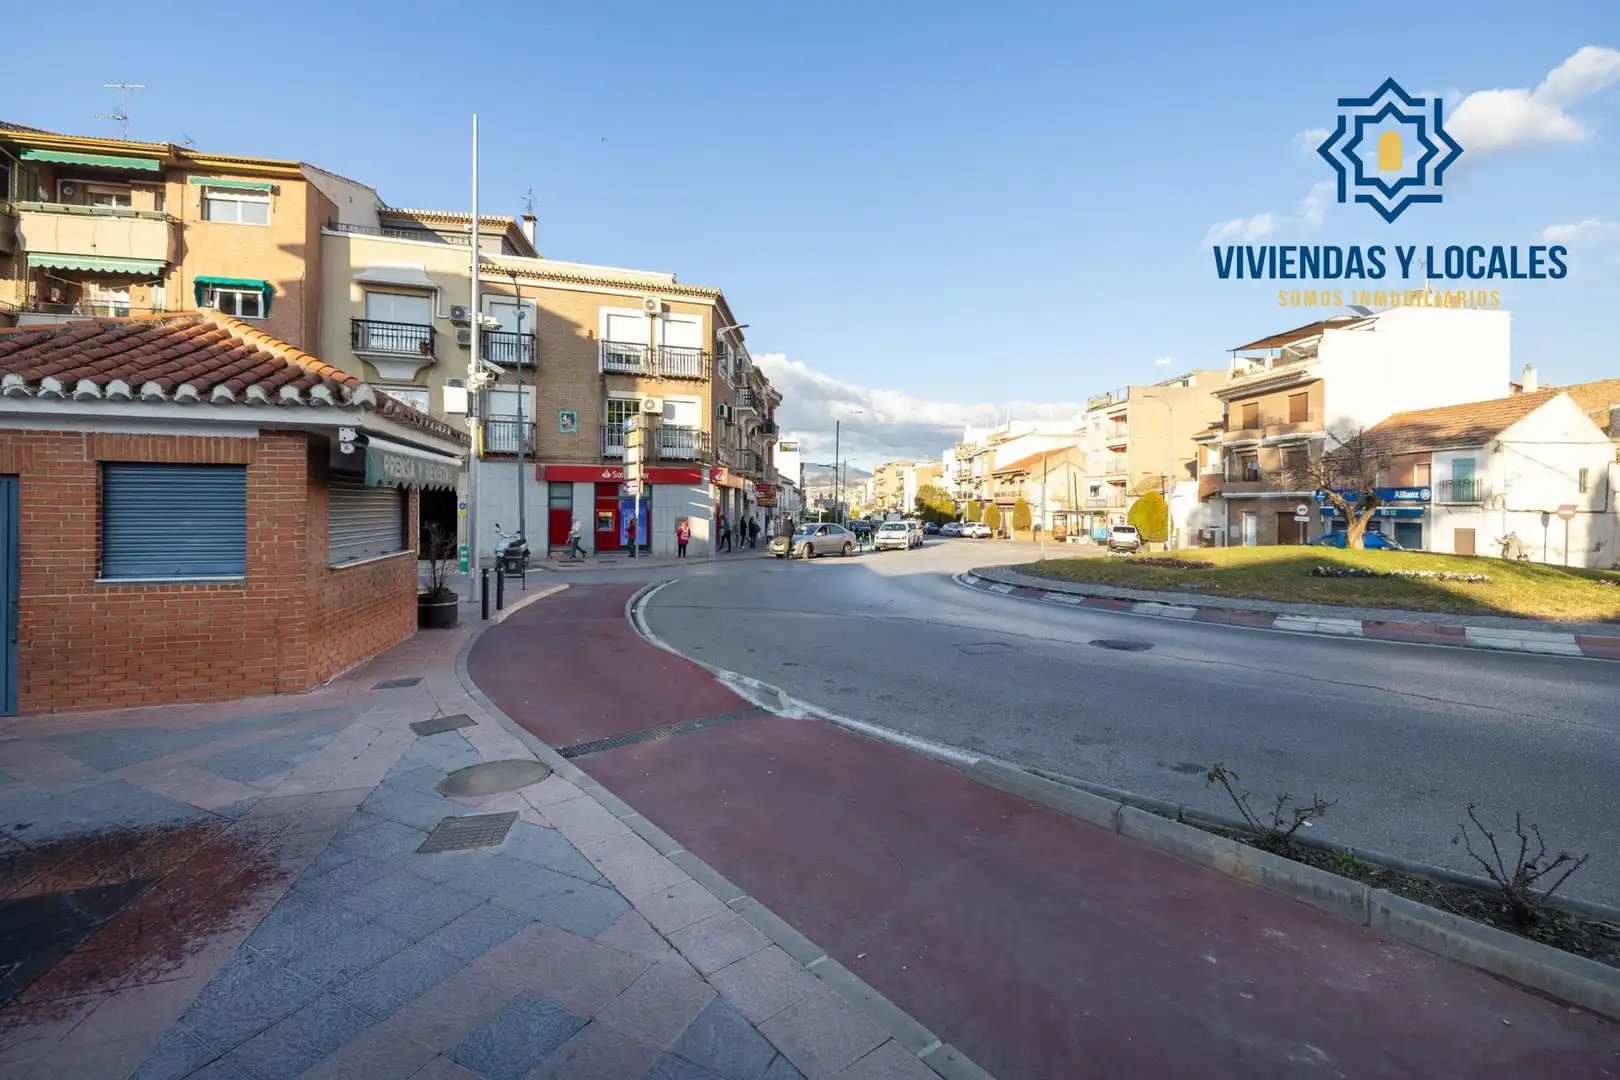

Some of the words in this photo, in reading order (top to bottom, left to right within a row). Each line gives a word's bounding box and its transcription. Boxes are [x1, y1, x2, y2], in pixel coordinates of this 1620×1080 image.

[383, 454, 416, 480] PRENSA
[417, 462, 424, 481] Y
[425, 463, 453, 482] REVISTAS
[1394, 490, 1420, 499] Allianz
